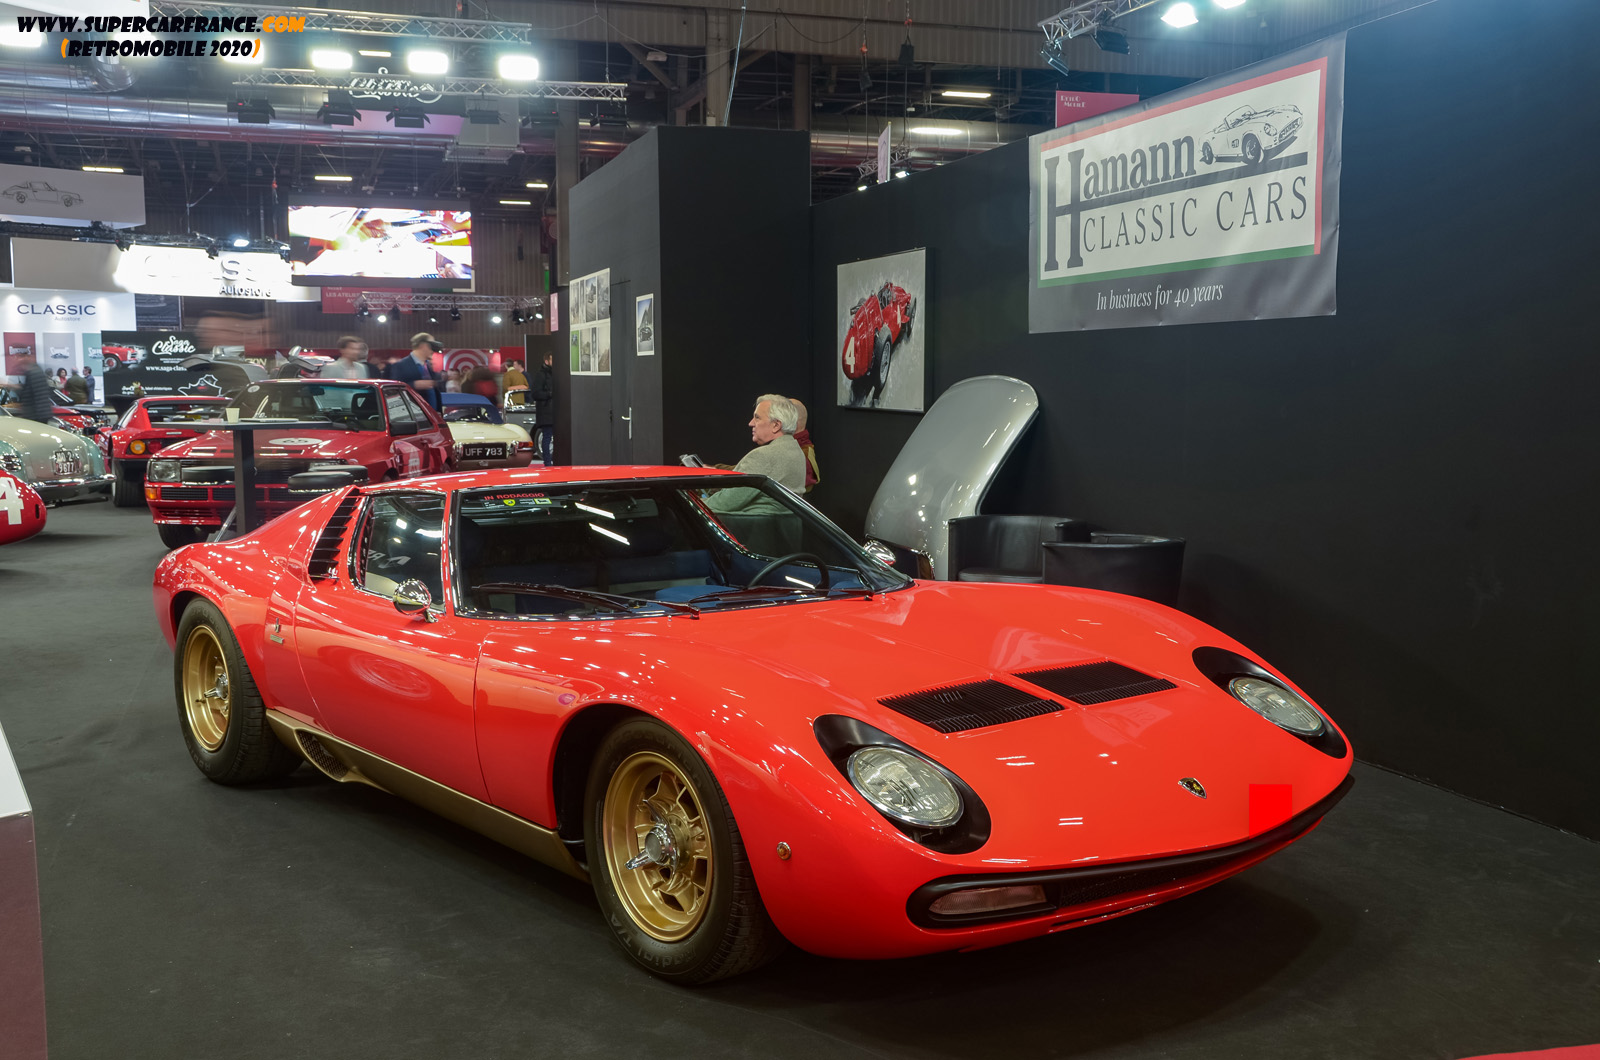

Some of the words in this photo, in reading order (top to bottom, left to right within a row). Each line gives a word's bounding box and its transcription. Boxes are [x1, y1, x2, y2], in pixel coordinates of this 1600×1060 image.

[1044, 135, 1197, 272] Hamann
[1083, 198, 1198, 252] CLASSIC
[1216, 176, 1308, 231] CARS
[1096, 292, 1107, 310] In
[1109, 288, 1152, 310] business
[1154, 284, 1173, 310] for
[1174, 288, 1190, 307] 40
[1190, 284, 1224, 307] years
[17, 304, 96, 315] CLASSIC
[152, 340, 196, 355] Classic
[168, 335, 191, 348] Saga
[845, 336, 855, 374] 4
[465, 448, 482, 456] UFF
[485, 447, 503, 456] 783
